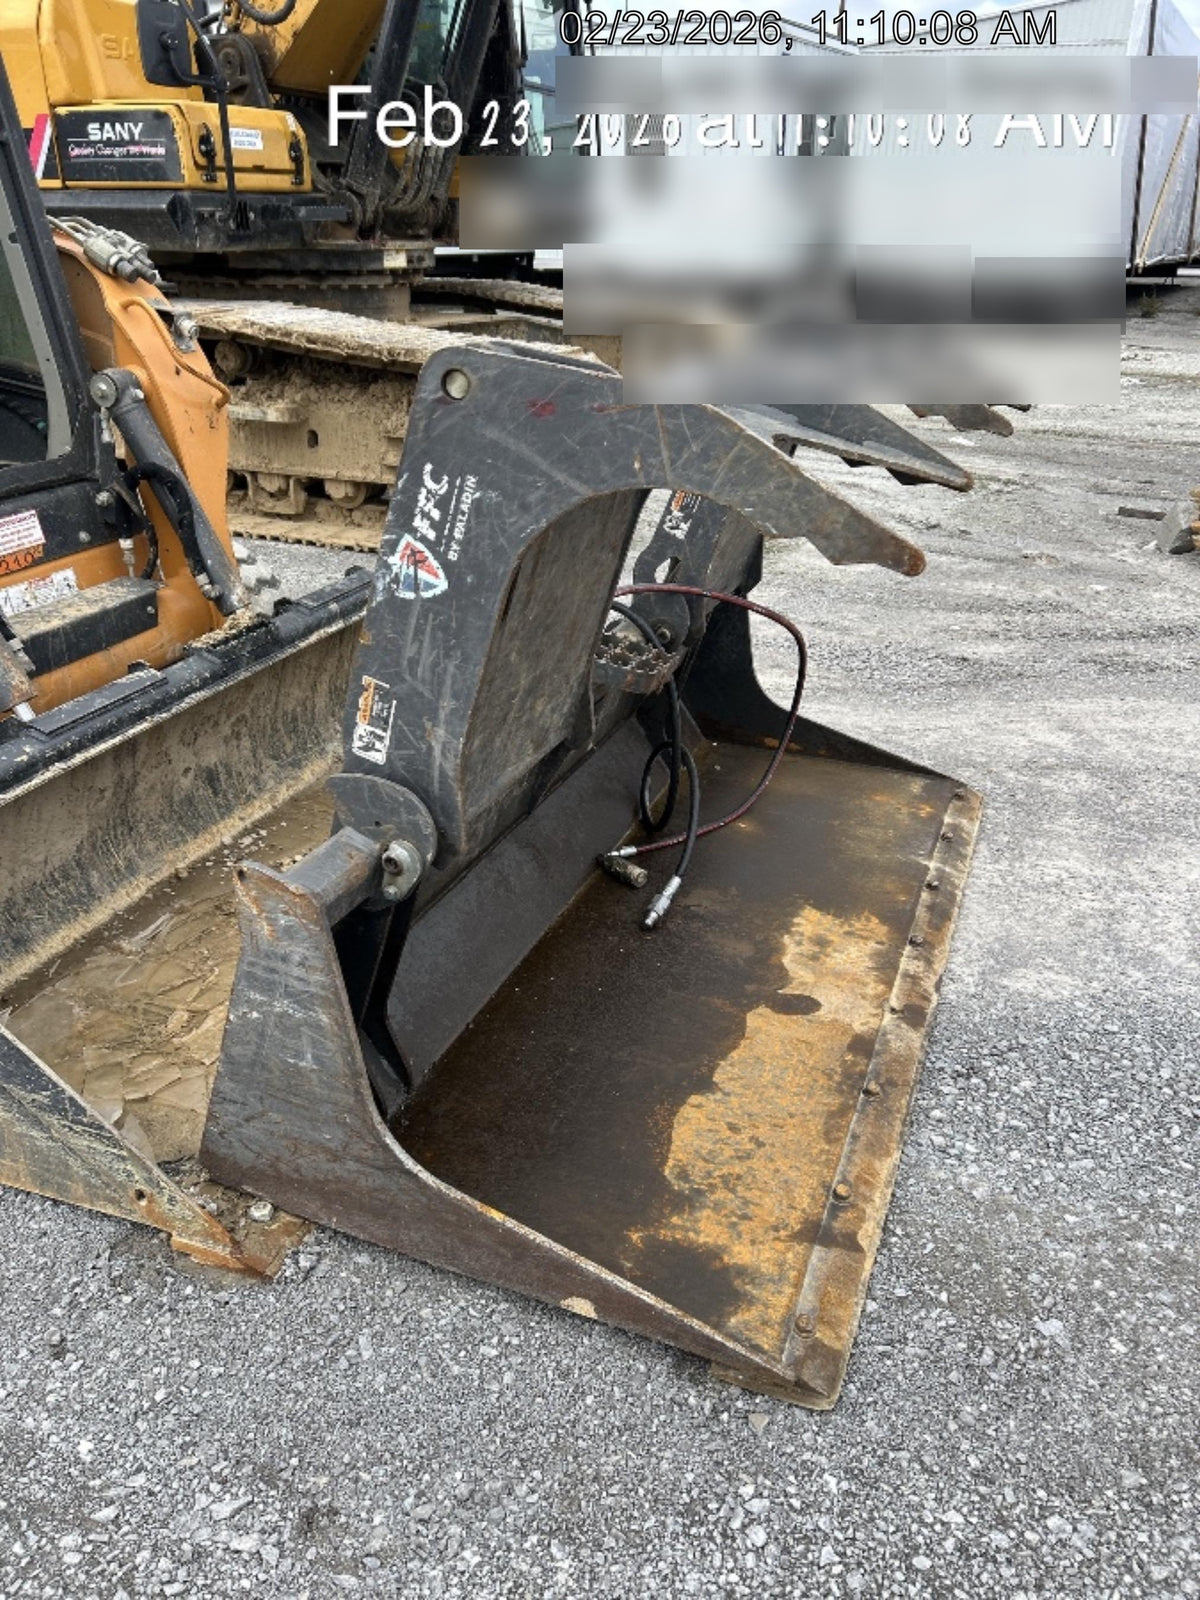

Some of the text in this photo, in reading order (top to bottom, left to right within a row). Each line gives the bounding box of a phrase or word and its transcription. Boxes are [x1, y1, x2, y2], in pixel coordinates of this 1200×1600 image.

[87, 122, 144, 141] SANY
[412, 462, 449, 541] FFC
[453, 474, 479, 541] PALADIN
